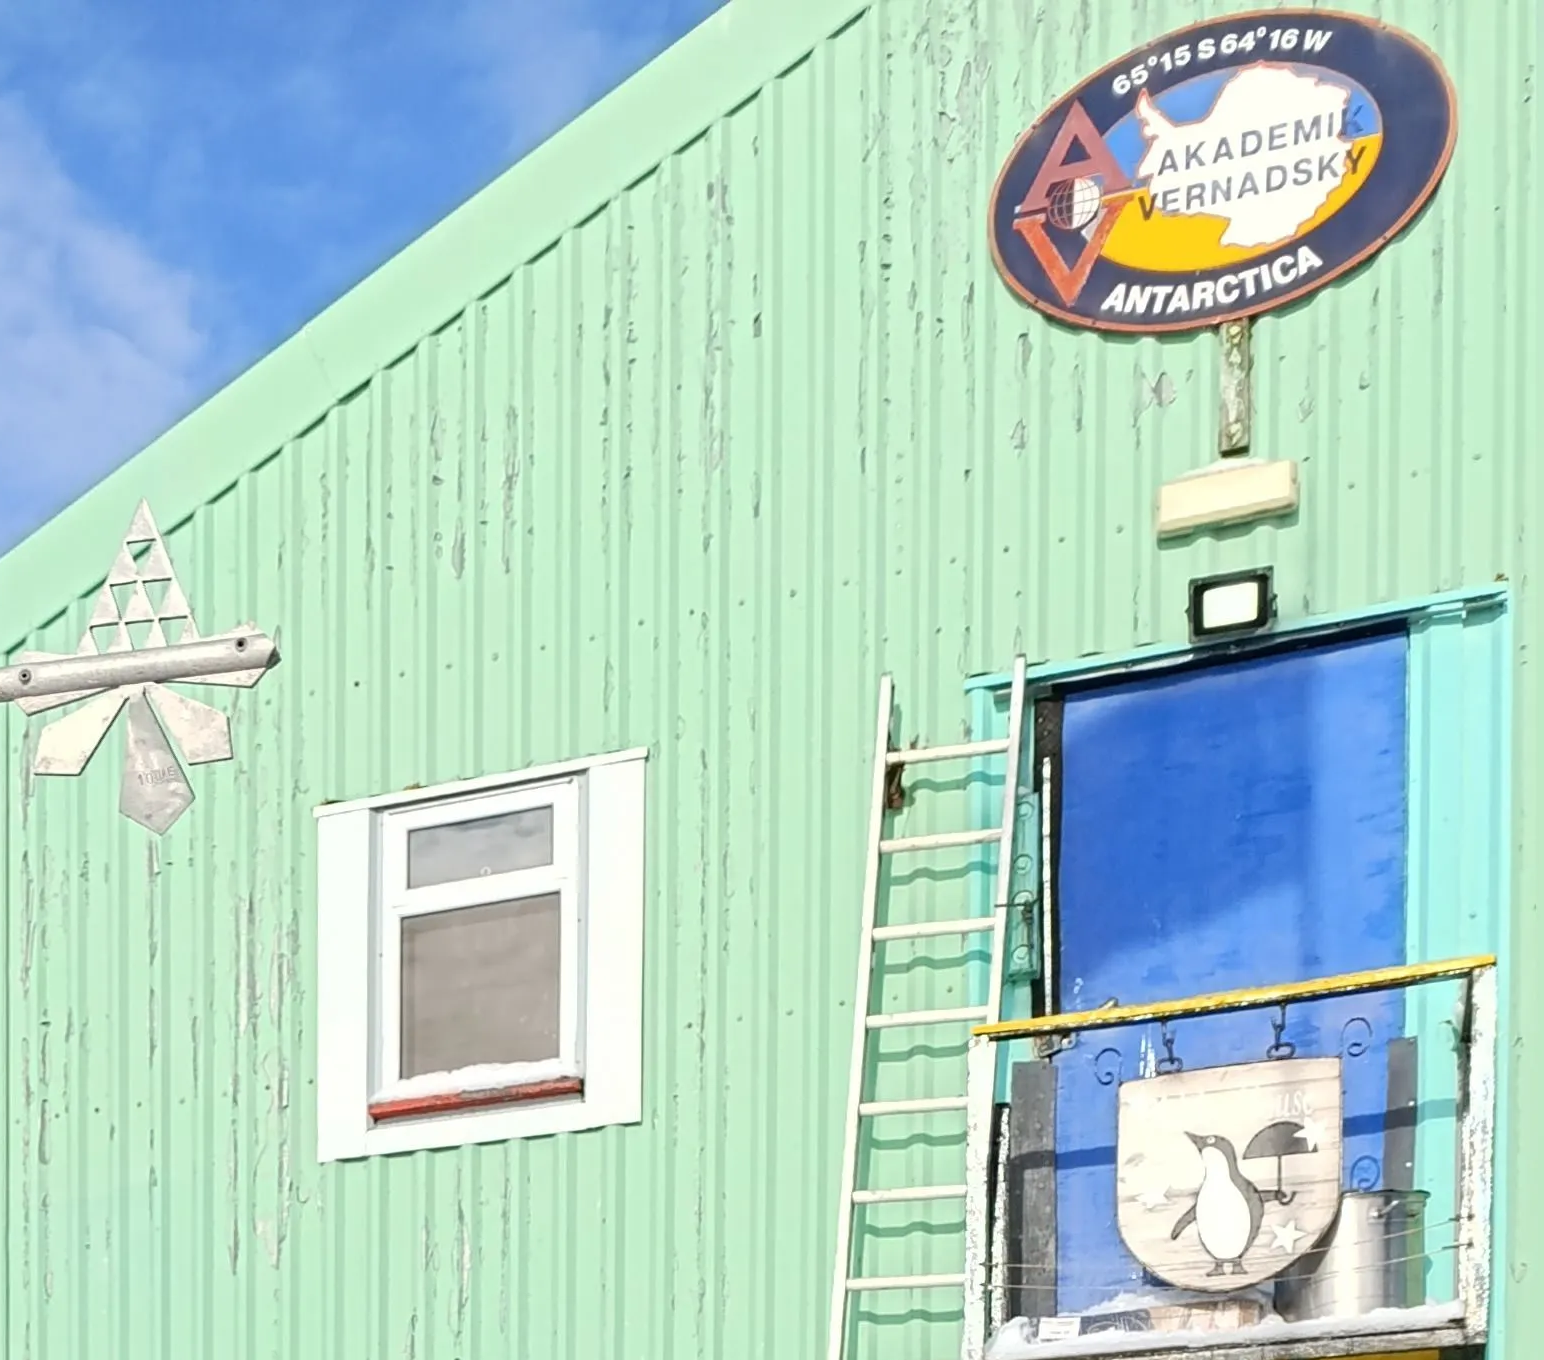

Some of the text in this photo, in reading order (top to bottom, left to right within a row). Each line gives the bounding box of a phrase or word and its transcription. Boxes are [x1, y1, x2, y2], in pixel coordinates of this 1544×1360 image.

[1157, 104, 1367, 176] AKADEMIK
[1138, 145, 1368, 222] VERNADSKY
[1101, 245, 1324, 316] ANTARCTICA
